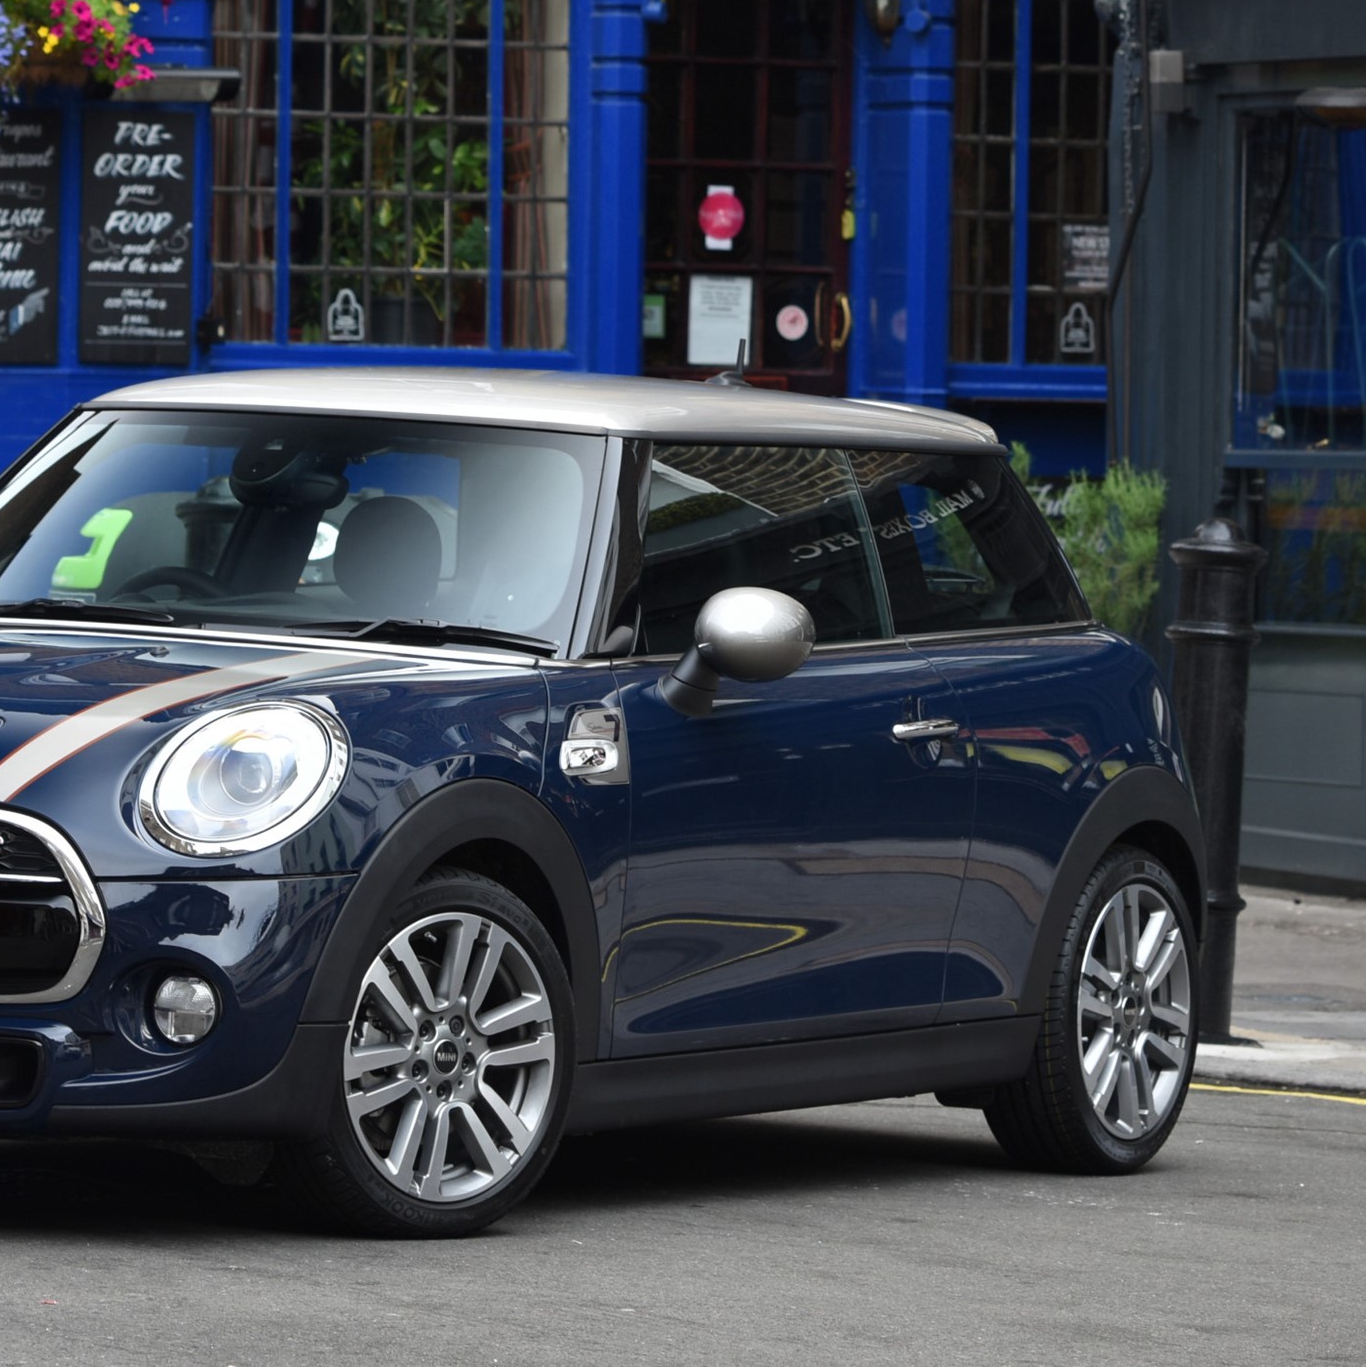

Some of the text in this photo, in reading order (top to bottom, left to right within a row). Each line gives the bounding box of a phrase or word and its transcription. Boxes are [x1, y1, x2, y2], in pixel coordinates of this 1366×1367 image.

[114, 121, 173, 147] PRE-
[93, 152, 185, 181] ORDER
[115, 184, 155, 206] your
[104, 210, 174, 234] FOOD
[122, 238, 154, 255] and
[437, 1052, 457, 1062] MINI
